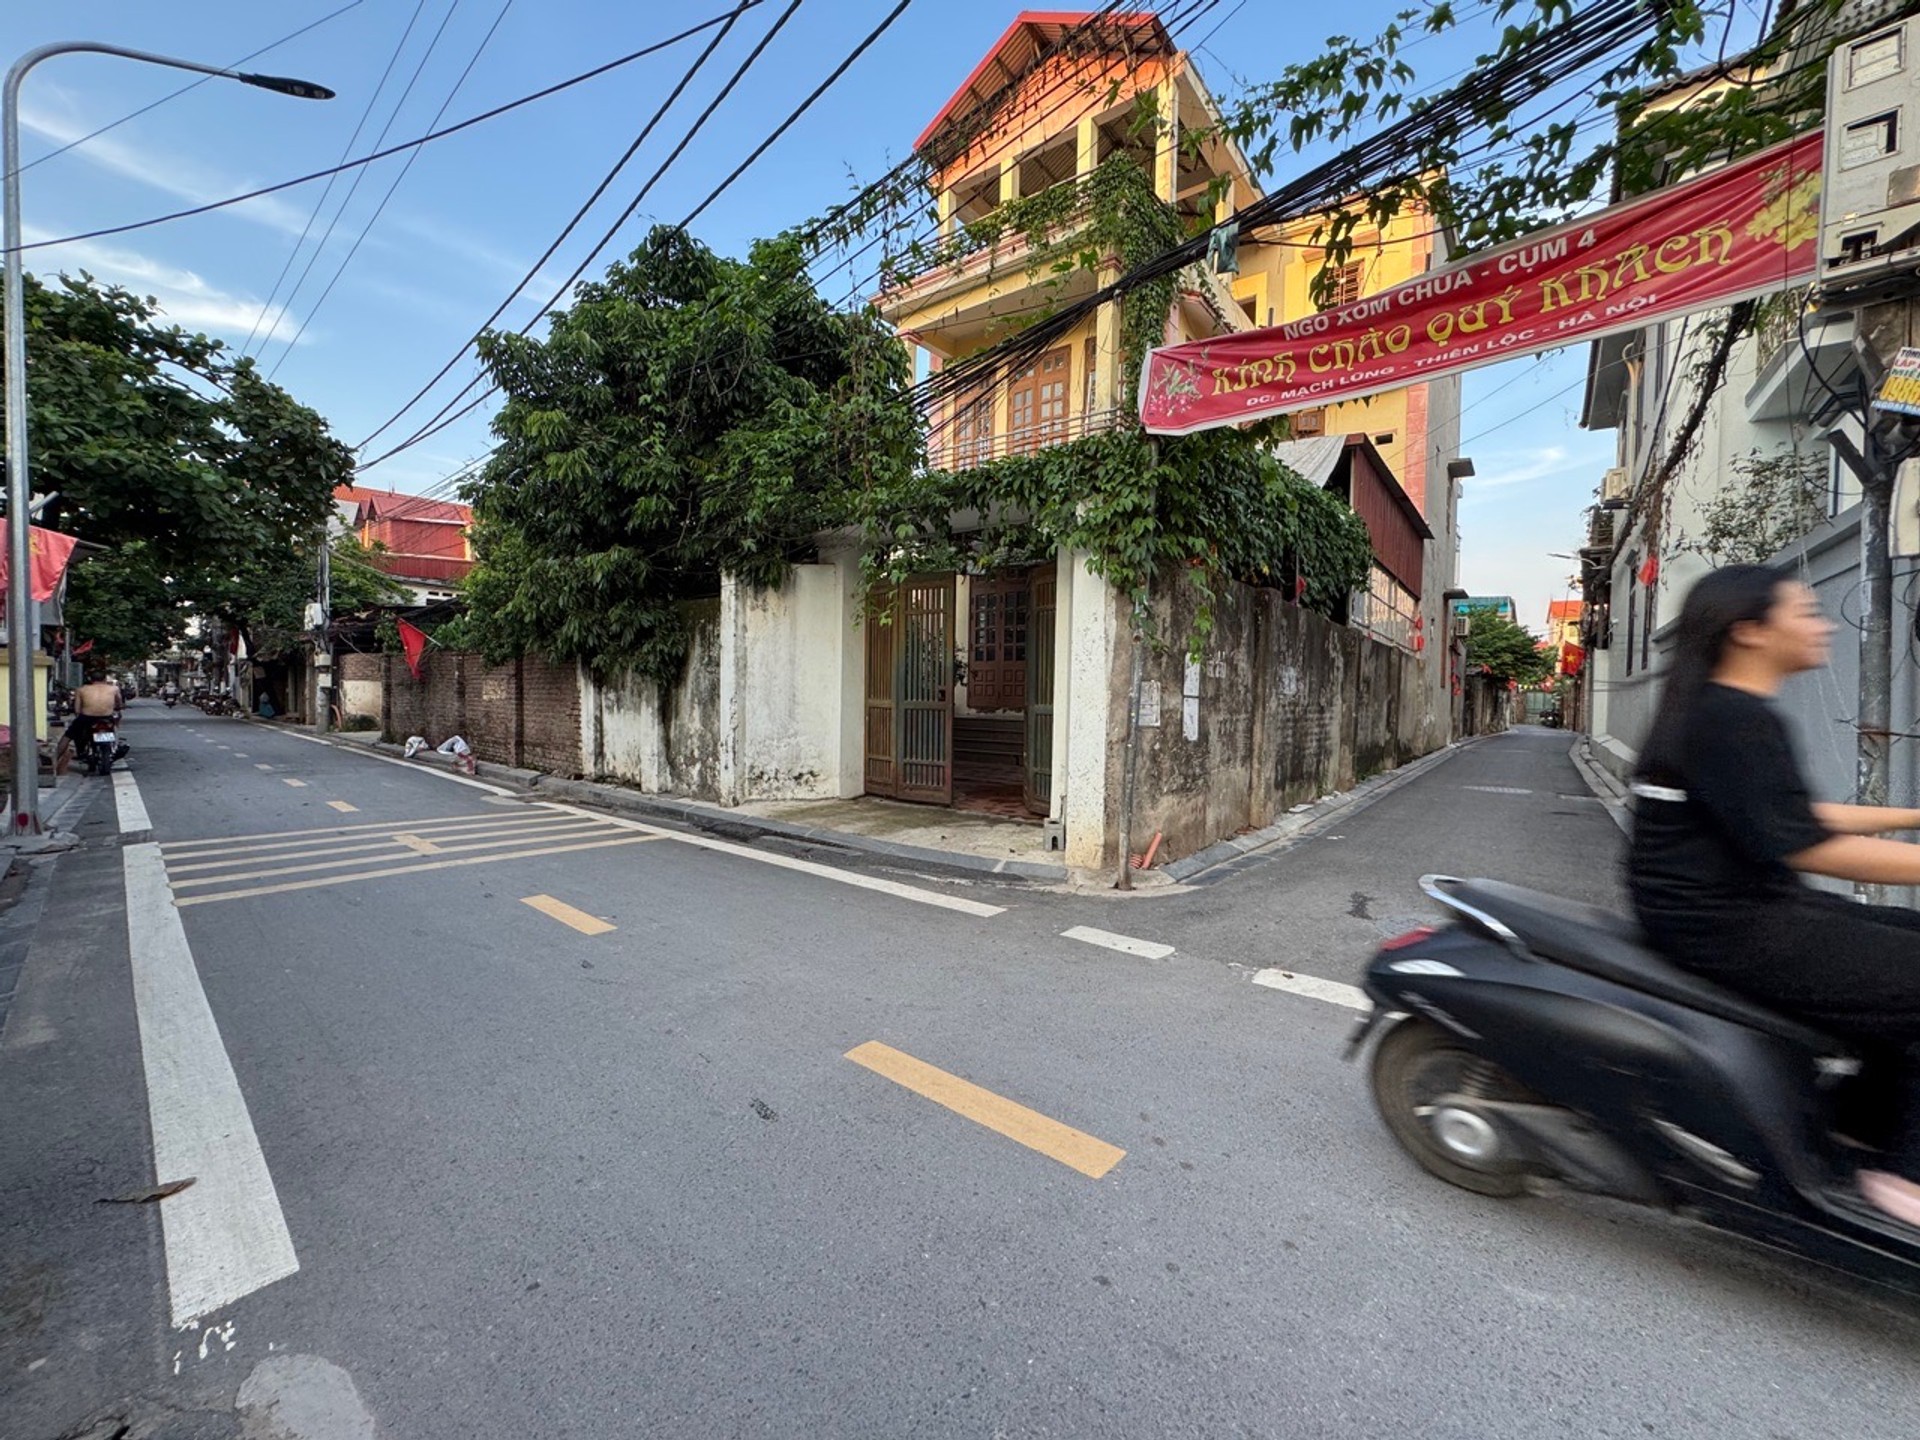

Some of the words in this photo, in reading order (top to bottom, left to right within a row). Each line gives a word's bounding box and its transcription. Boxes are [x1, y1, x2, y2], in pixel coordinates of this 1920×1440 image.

[1498, 237, 1568, 274] CỤM
[1577, 229, 1597, 248] 4
[1211, 351, 1296, 396] KÍNH
[1308, 326, 1411, 374] CHÀO
[1426, 285, 1523, 347] QUÝ
[1538, 219, 1733, 313] KHÁCH
[1281, 379, 1334, 400] MẠCH
[1414, 343, 1479, 368] THIÊN
[1486, 328, 1535, 350] LỘC
[1558, 310, 1596, 330] HÀ
[1606, 294, 1657, 317] NỘI
